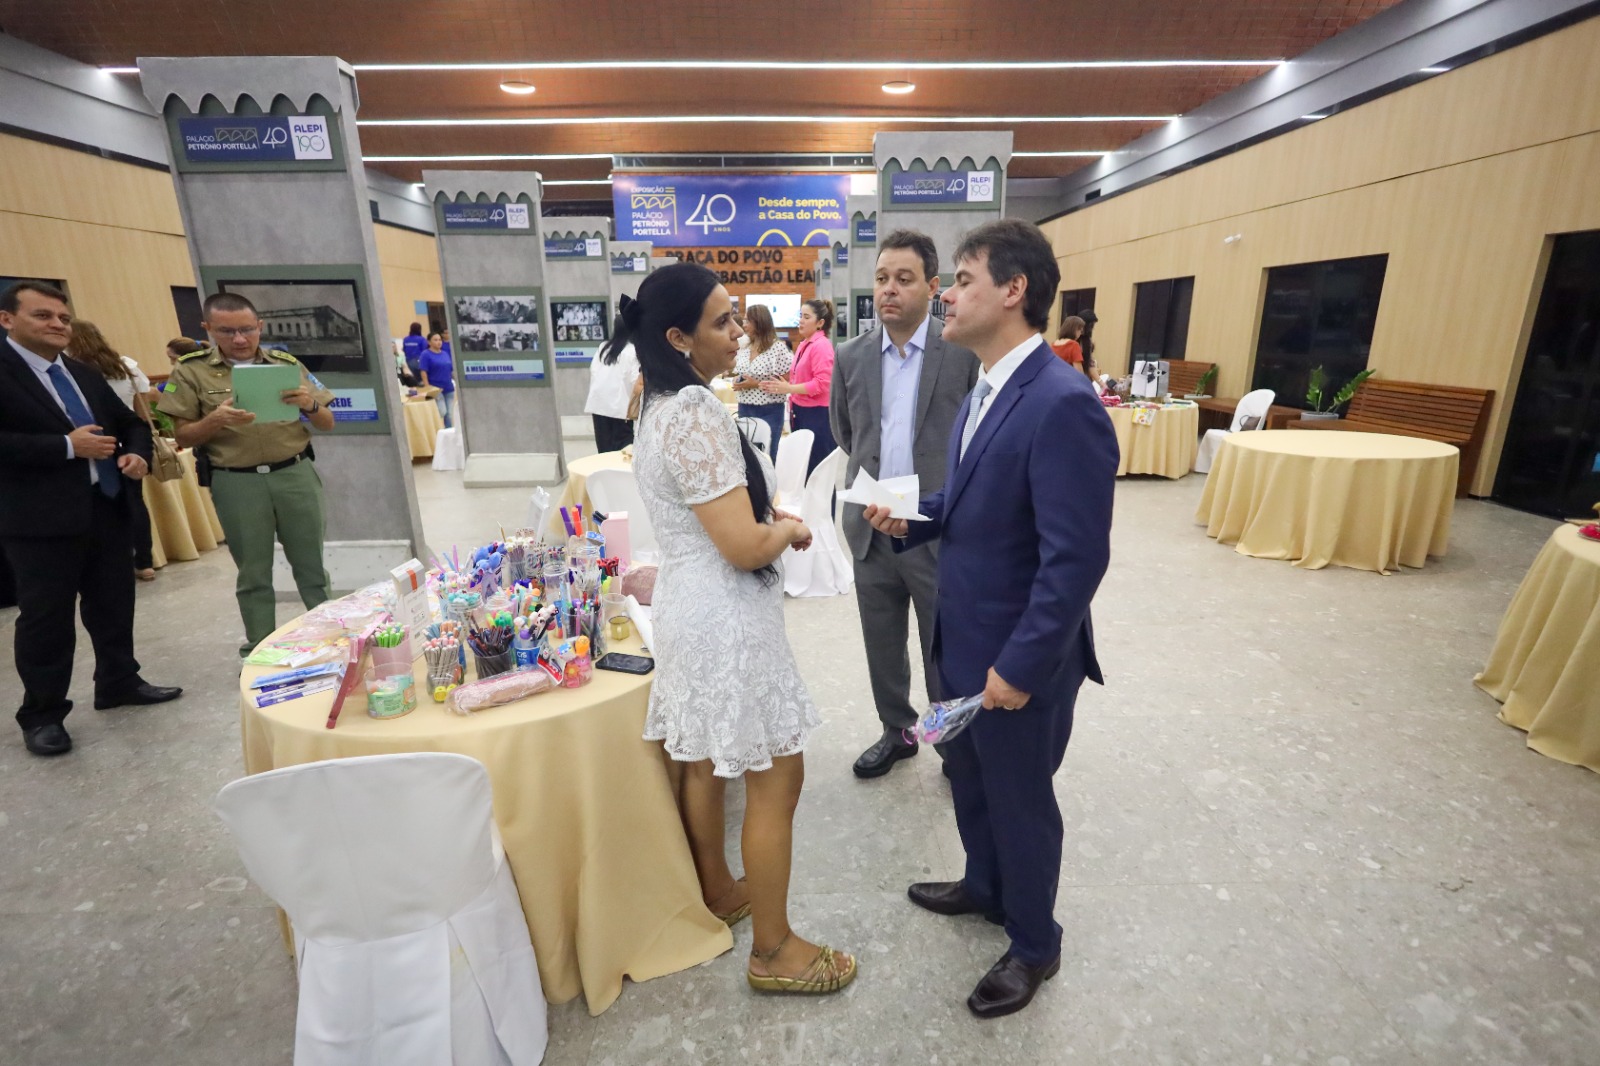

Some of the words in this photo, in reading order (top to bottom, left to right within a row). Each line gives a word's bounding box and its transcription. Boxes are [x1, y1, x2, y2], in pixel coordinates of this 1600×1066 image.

[294, 124, 323, 133] ALEPI
[262, 126, 287, 149] 40
[296, 135, 325, 152] 190
[188, 142, 221, 150] PETRÔNIO
[222, 142, 257, 150] PORTELLA
[946, 178, 966, 194] 40
[758, 197, 793, 207] Desde
[795, 199, 839, 209] sempre,
[489, 209, 505, 222] 40
[684, 193, 736, 235] 40
[758, 211, 766, 219] a
[768, 210, 794, 220] Casa
[796, 209, 811, 219] do
[813, 210, 842, 220] Povo.
[632, 219, 669, 228] PETRÔNIO
[632, 228, 671, 236] PORTELLA
[718, 249, 739, 264] DO
[743, 249, 783, 264] POVO
[330, 397, 352, 408] SEDE
